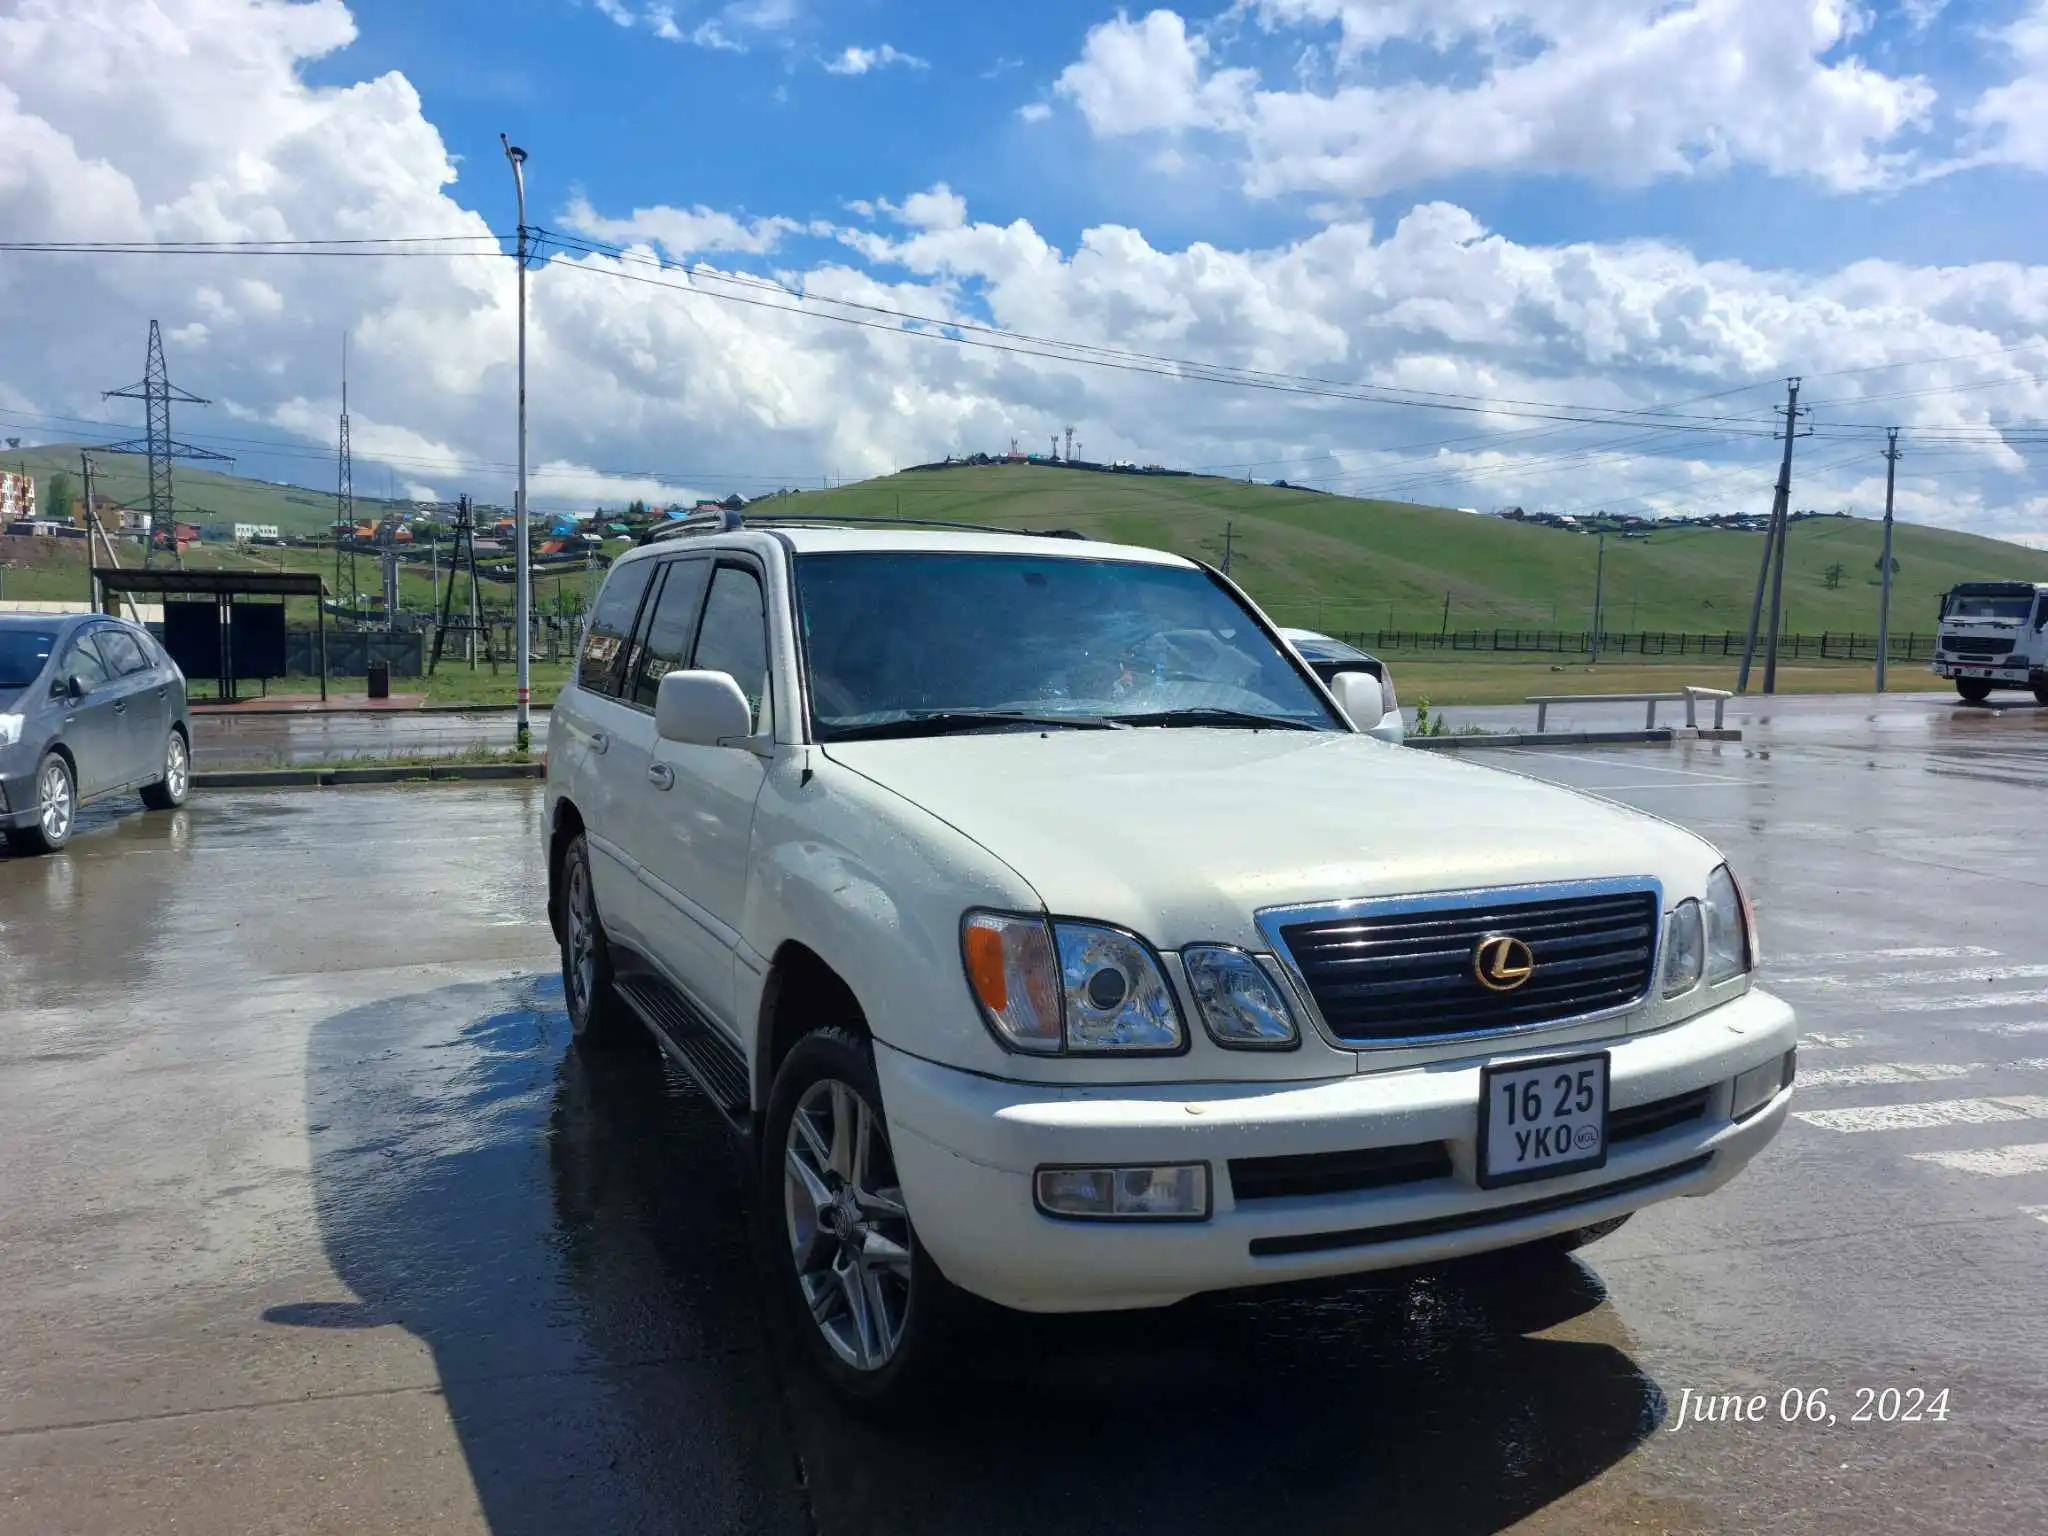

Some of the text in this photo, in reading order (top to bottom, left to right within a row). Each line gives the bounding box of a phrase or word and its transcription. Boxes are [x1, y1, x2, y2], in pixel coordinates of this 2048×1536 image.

[1503, 1069, 1594, 1126] 16 25
[1515, 1124, 1573, 1162] УКО
